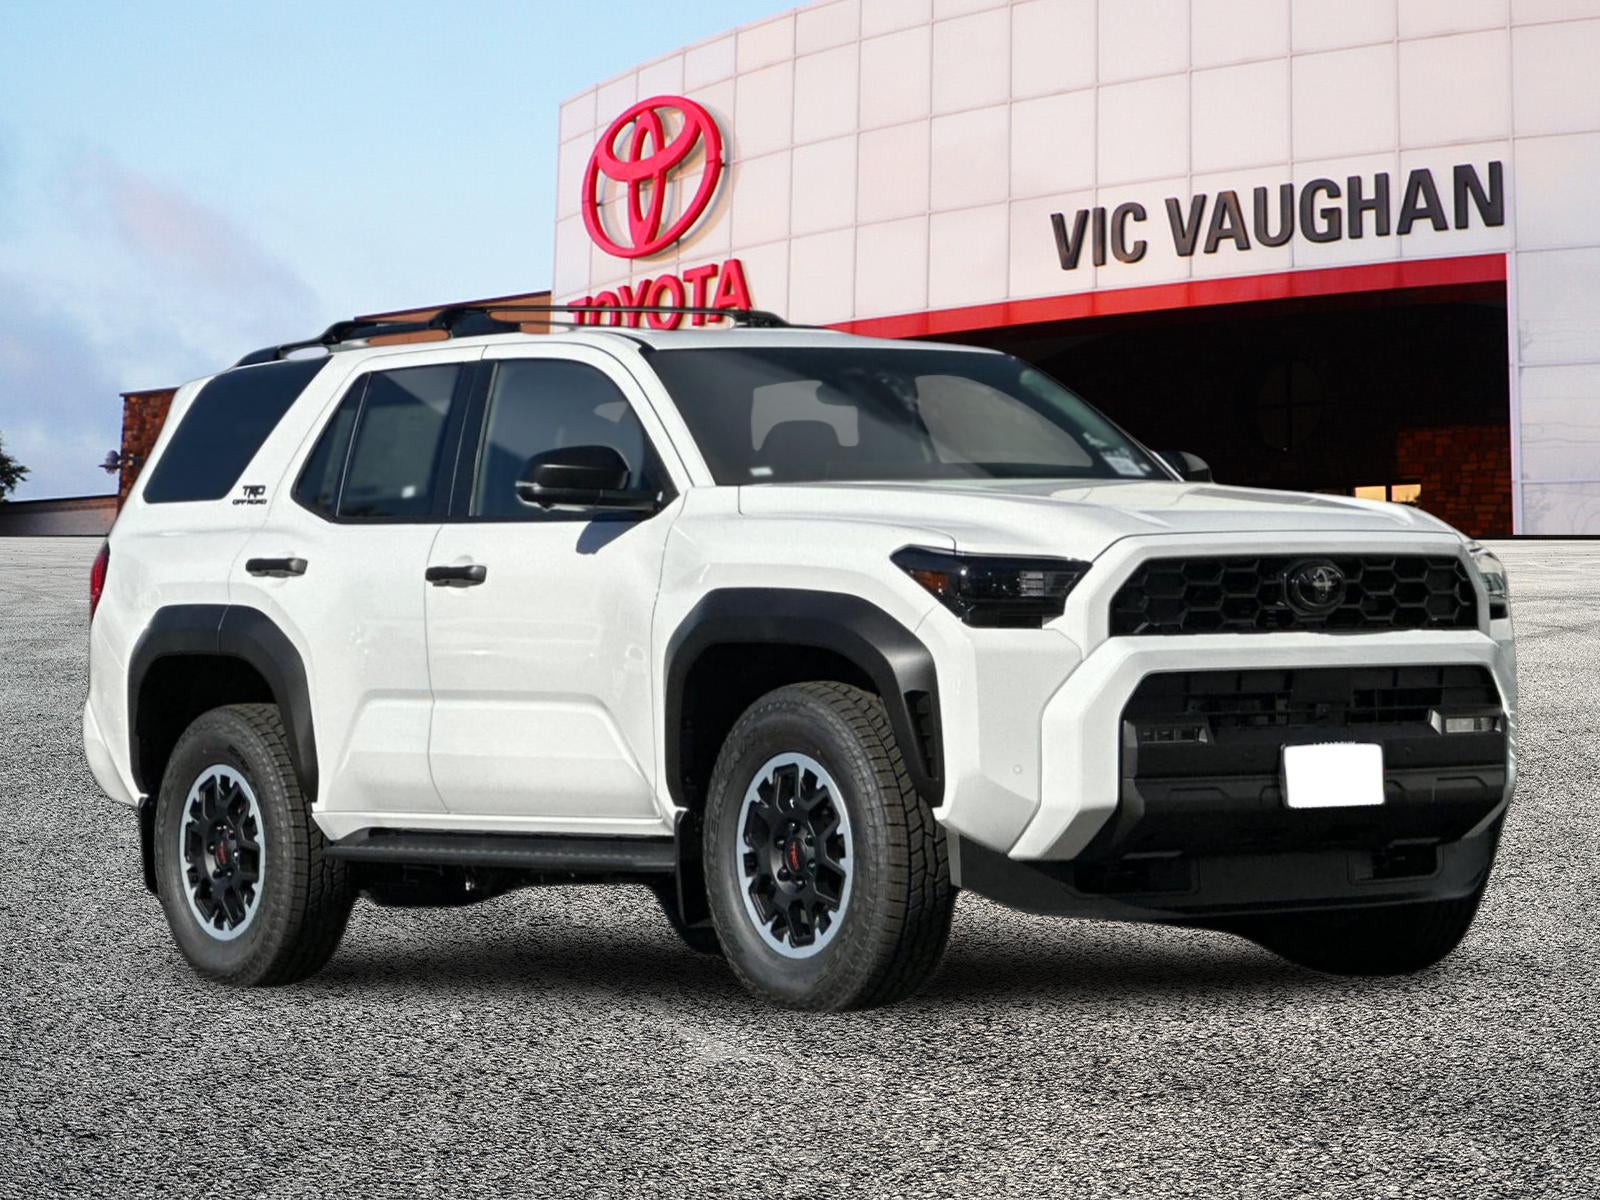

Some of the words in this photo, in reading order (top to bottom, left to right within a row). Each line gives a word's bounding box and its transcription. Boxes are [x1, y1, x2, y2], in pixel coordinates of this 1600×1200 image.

[1050, 202, 1147, 271] VIC
[1165, 160, 1505, 257] VAUGHAN
[567, 258, 753, 330] TOYOTA
